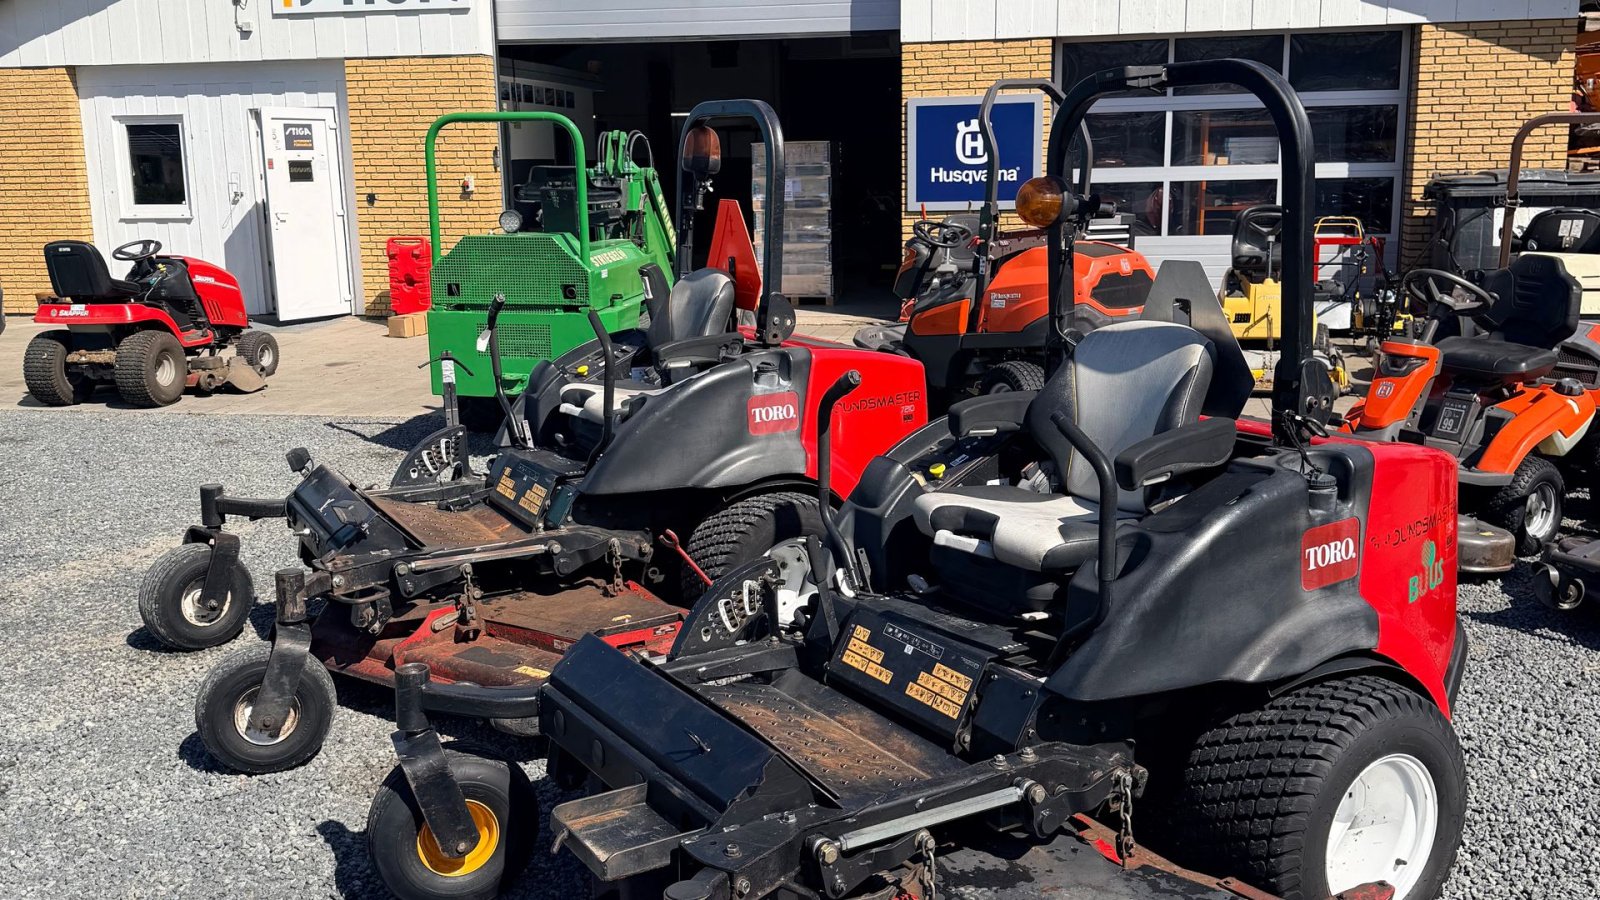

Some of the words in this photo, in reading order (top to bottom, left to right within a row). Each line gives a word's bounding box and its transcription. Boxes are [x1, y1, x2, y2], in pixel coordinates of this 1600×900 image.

[286, 127, 312, 136] STIGA
[930, 167, 1018, 184] Husqvana
[833, 390, 921, 414] OUNDSMASTER
[1441, 417, 1454, 431] 99
